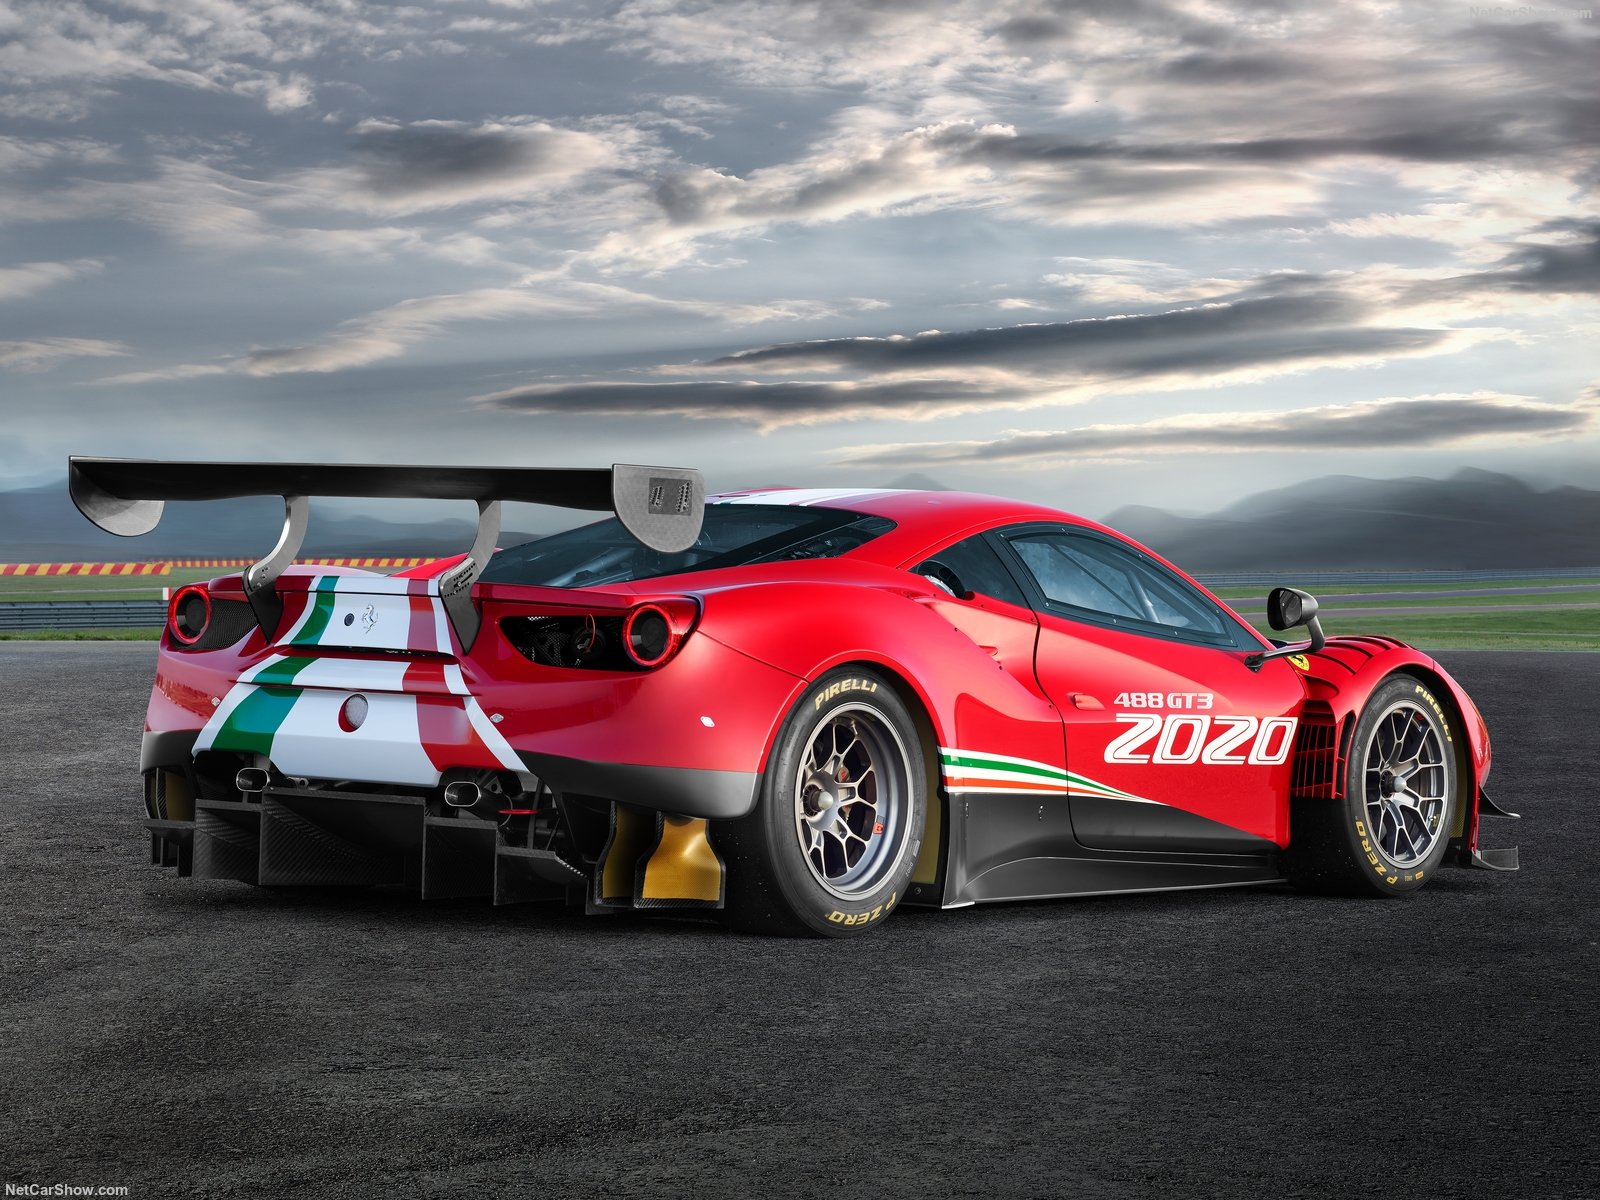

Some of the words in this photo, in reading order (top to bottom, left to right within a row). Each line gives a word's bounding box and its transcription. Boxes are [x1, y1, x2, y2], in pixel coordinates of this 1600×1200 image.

[814, 678, 878, 711] PIRELLI
[1113, 692, 1164, 709] 488
[1166, 692, 1214, 710] GT3
[1415, 684, 1453, 742] PIRELLI
[1103, 713, 1299, 766] 2020
[1355, 821, 1387, 876] ZERO
[1386, 875, 1398, 885] P
[885, 891, 897, 911] P
[828, 905, 883, 925] ZERO
